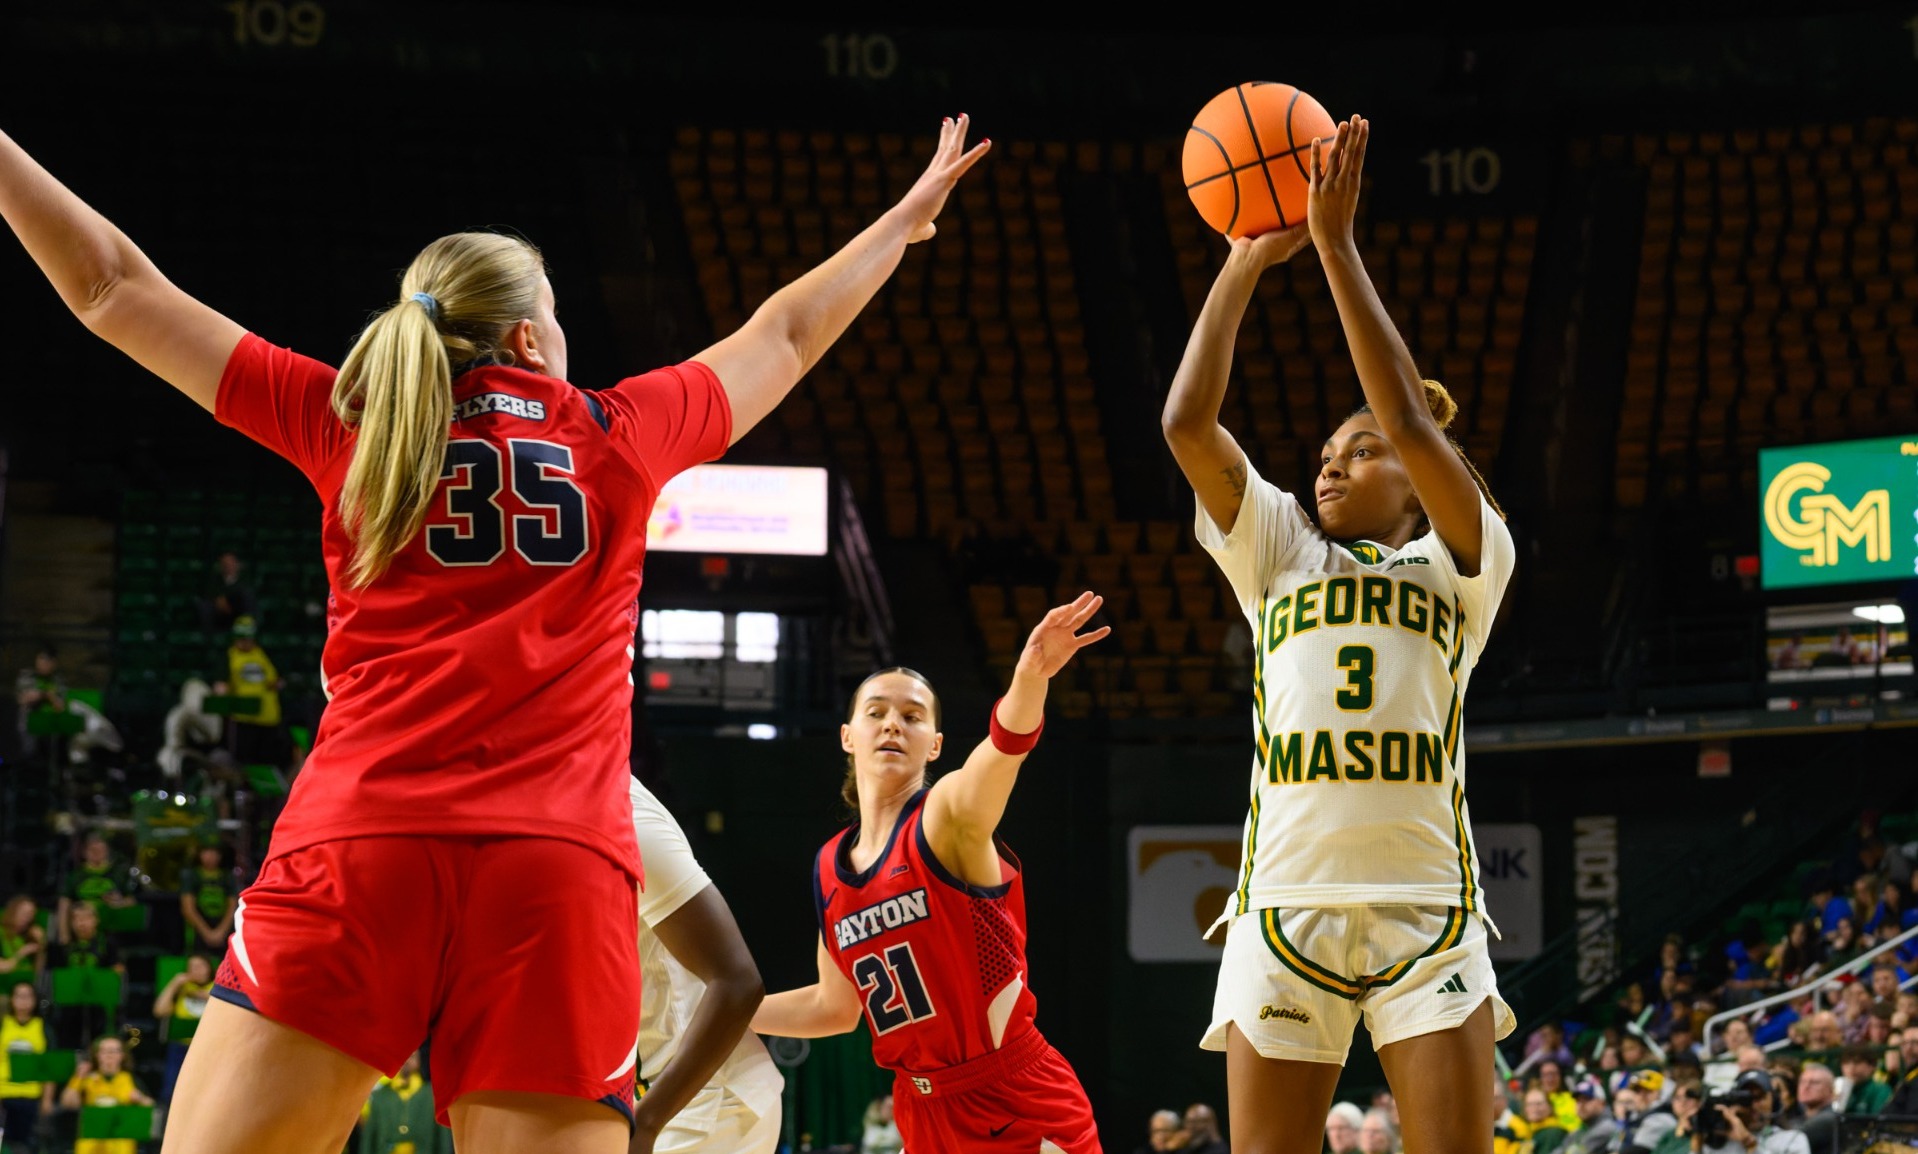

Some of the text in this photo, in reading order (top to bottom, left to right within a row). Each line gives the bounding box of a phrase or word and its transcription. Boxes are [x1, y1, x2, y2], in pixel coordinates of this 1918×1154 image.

[225, 0, 326, 47] 109
[819, 32, 899, 79] 110
[1418, 146, 1502, 196] 110
[426, 438, 590, 567] 35
[1268, 574, 1451, 658] GEORGE
[1334, 643, 1377, 714] 3
[1267, 729, 1444, 786] MASON
[1479, 847, 1529, 880] NK
[852, 941, 937, 1037] 21
[1259, 1004, 1311, 1024] Patriots
